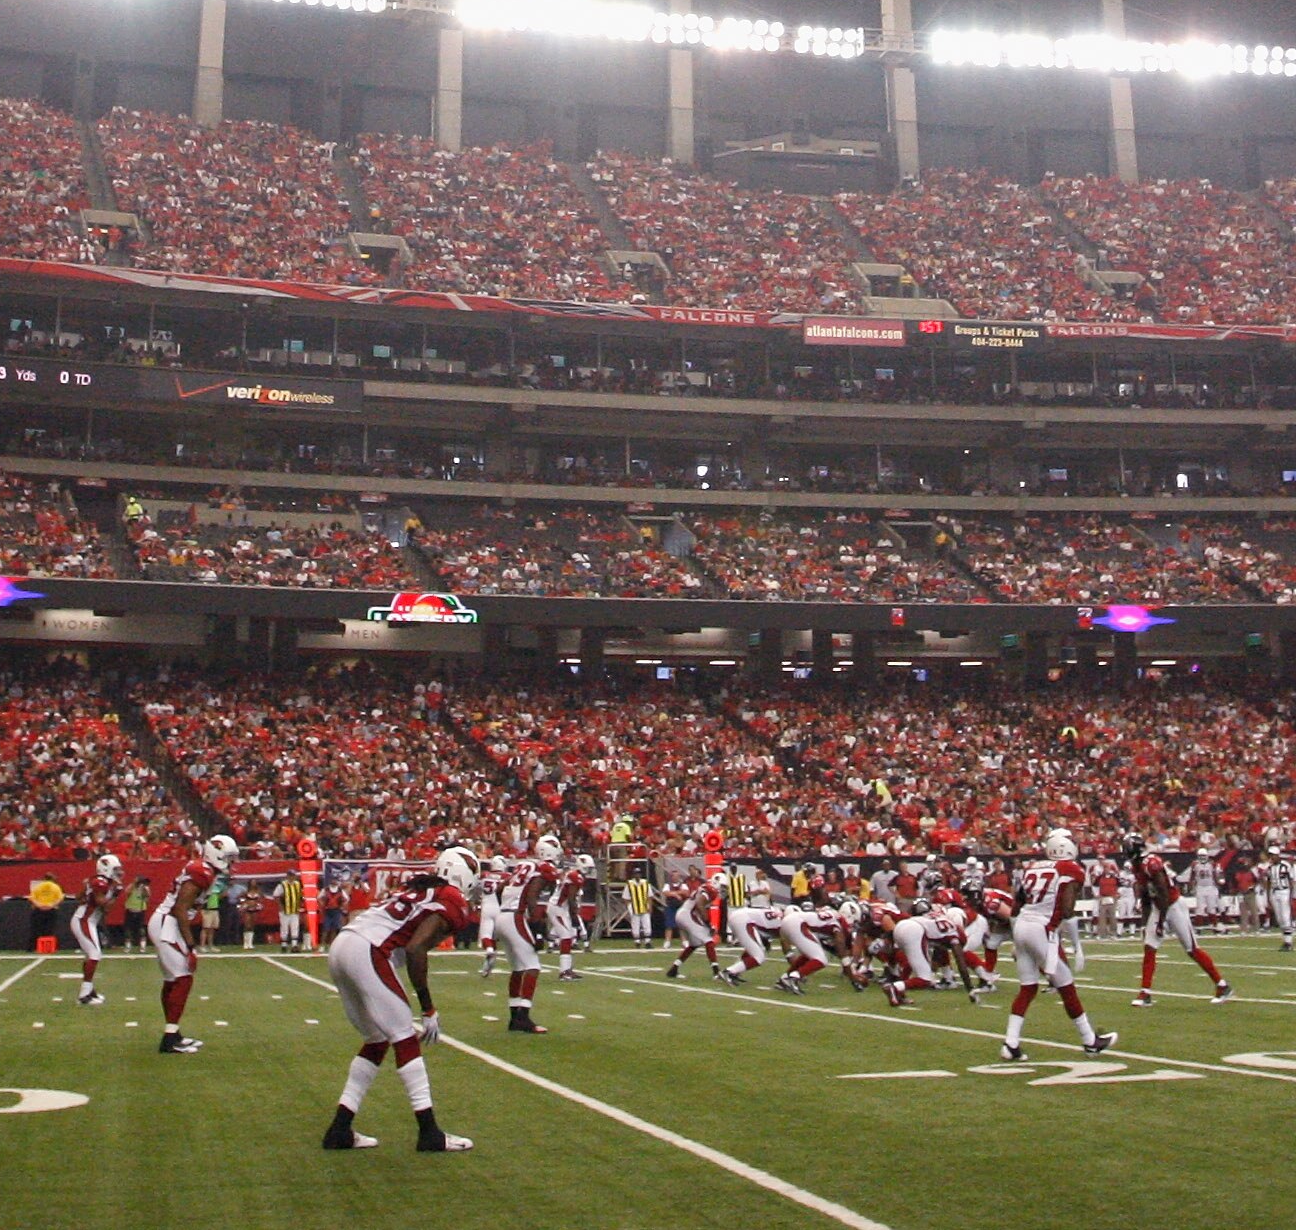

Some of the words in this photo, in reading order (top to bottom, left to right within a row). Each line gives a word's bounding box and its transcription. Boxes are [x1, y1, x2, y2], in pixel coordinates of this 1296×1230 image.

[660, 310, 755, 324] FALCONS
[806, 325, 903, 341] atlantafalcons.com
[992, 327, 1015, 337] Ticket
[1017, 328, 1039, 338] Packs
[1047, 326, 1128, 336] FALCONS
[15, 368, 37, 383] Yds
[74, 373, 91, 386] TD
[53, 620, 109, 631] WOMEN
[351, 628, 380, 638] MEN
[1023, 872, 1054, 905] 27
